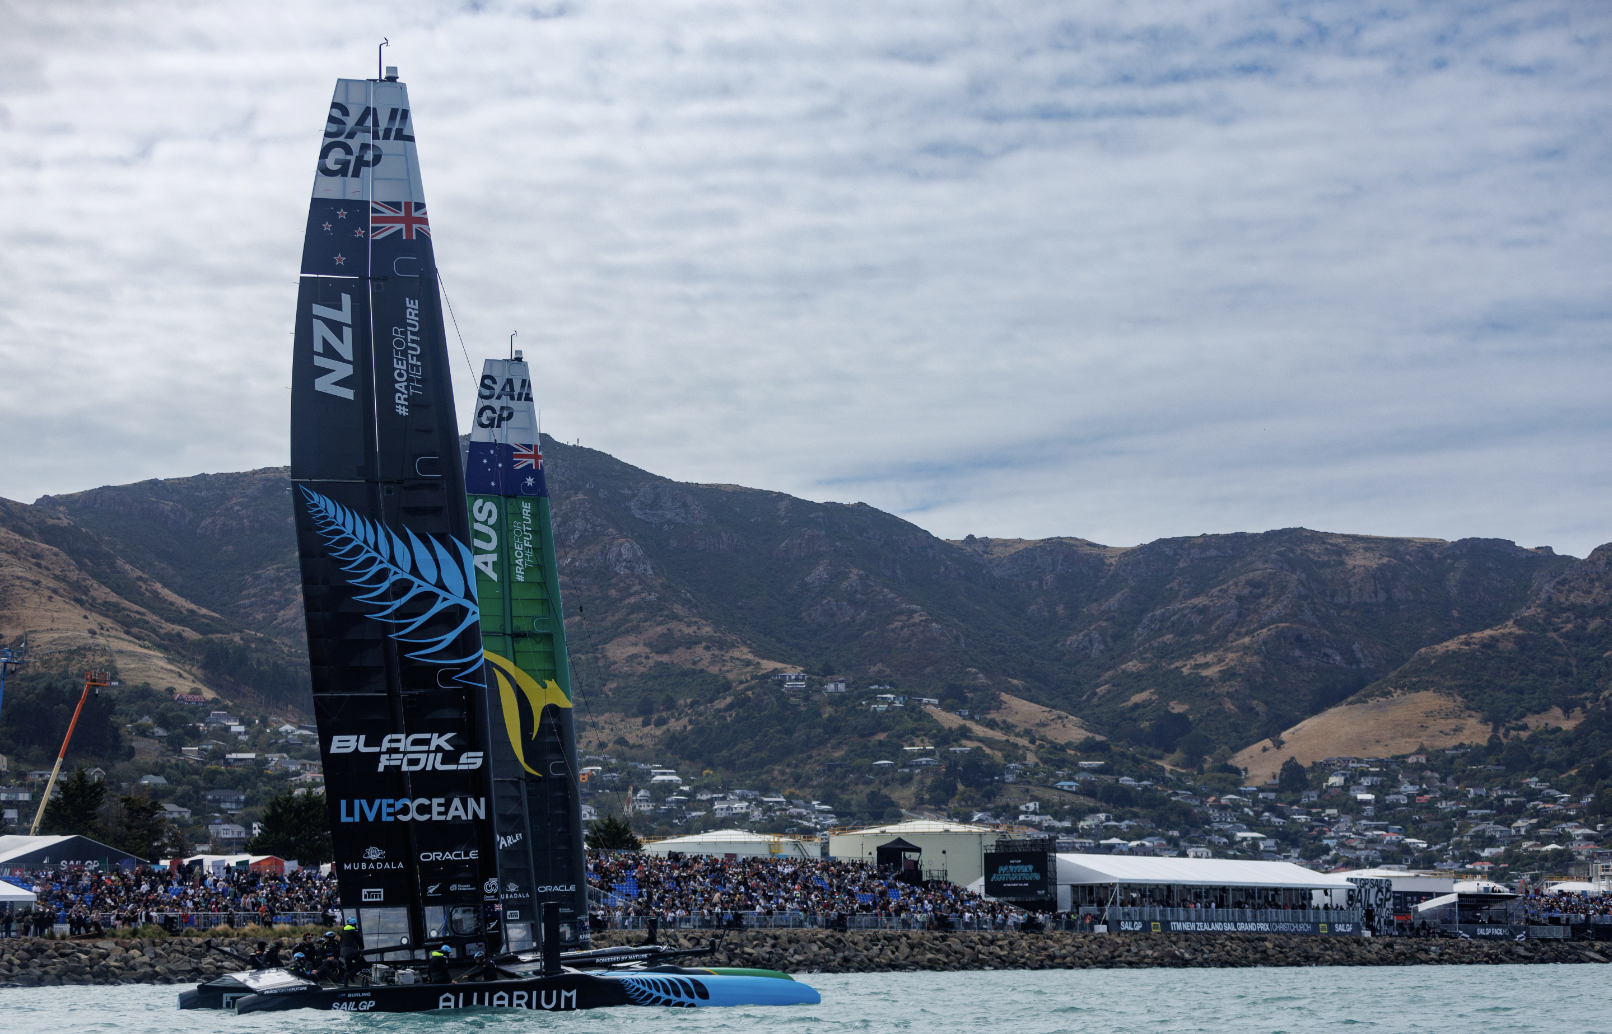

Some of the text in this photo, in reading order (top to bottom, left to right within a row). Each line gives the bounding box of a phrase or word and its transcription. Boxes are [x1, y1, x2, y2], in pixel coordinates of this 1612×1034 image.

[324, 102, 415, 143] SAIL
[318, 141, 383, 178] GP
[312, 293, 355, 401] NZL
[478, 374, 534, 402] SAIL
[476, 405, 514, 429] GP
[473, 499, 498, 582] AUS
[329, 732, 458, 754] BLACK
[377, 751, 484, 772] FOILS
[343, 861, 404, 871] MUBADALA
[420, 850, 479, 862] ORACLE
[501, 892, 530, 900] UBADALA
[537, 884, 576, 893] ORACLE
